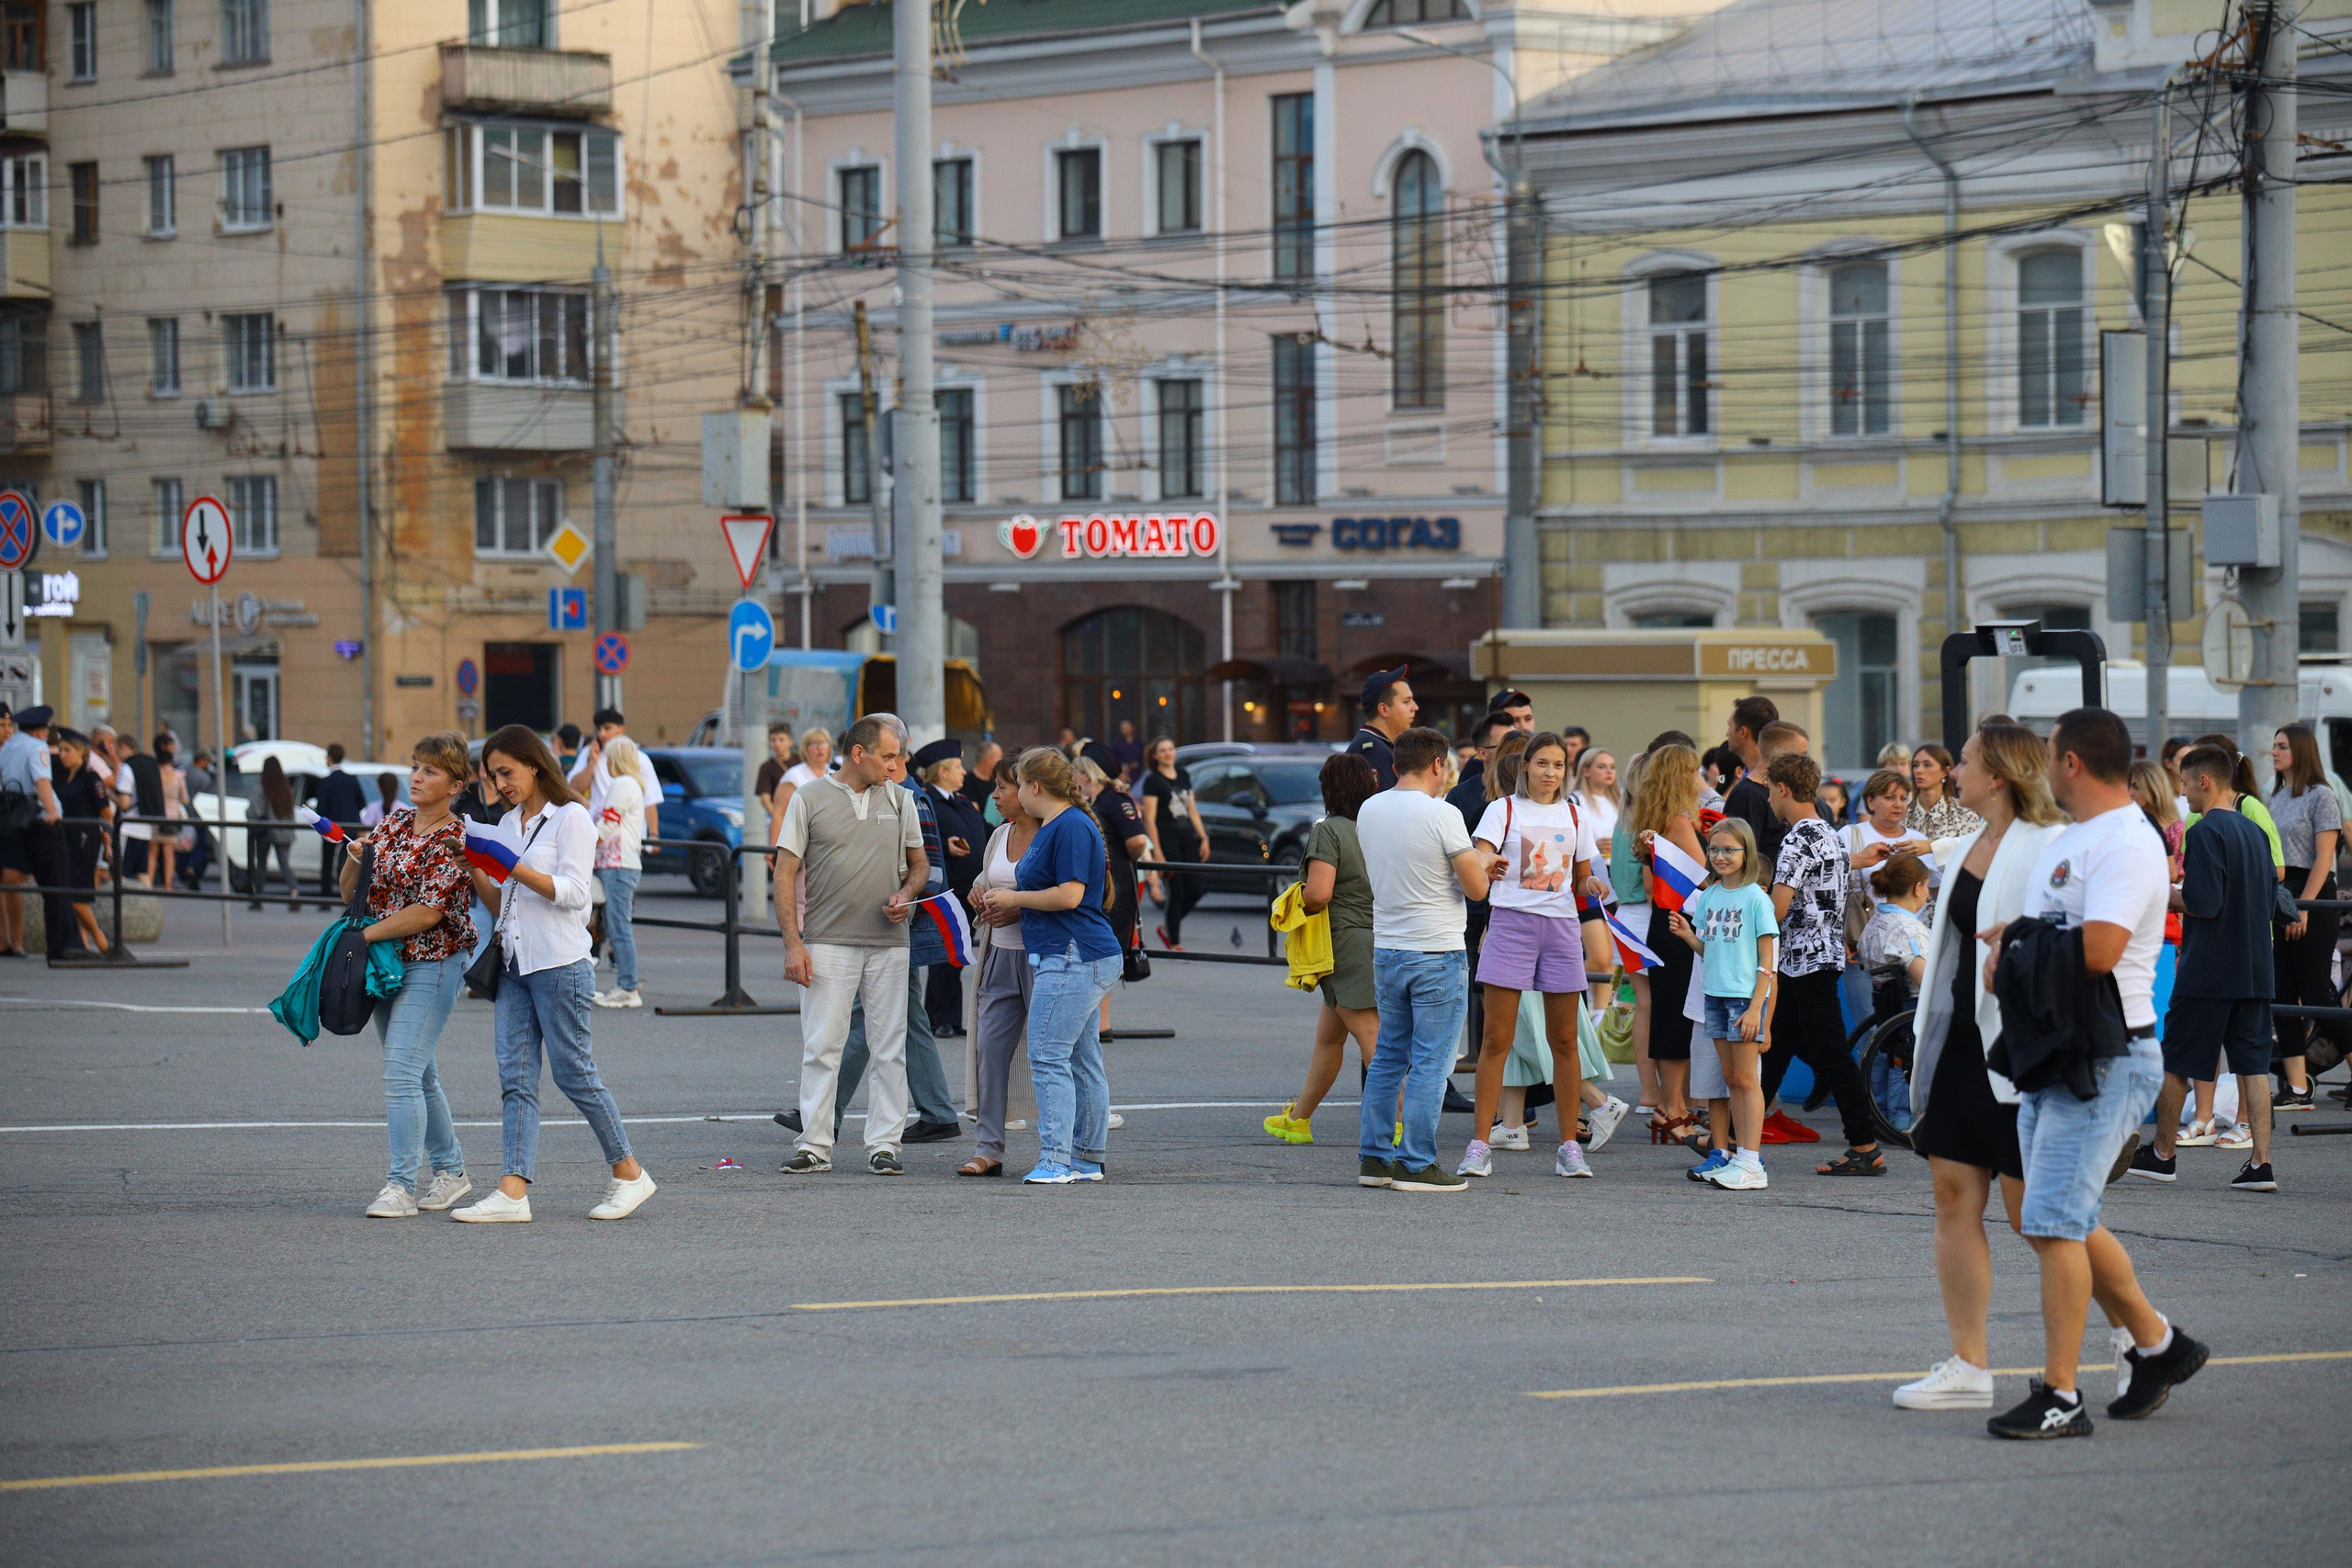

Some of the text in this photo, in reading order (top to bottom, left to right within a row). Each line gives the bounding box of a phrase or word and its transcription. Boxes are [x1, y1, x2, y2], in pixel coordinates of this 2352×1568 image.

[1058, 513, 1219, 556] TOMATO
[1332, 517, 1461, 550] СОГАЗ
[1728, 648, 1809, 671] ПРЕССА
